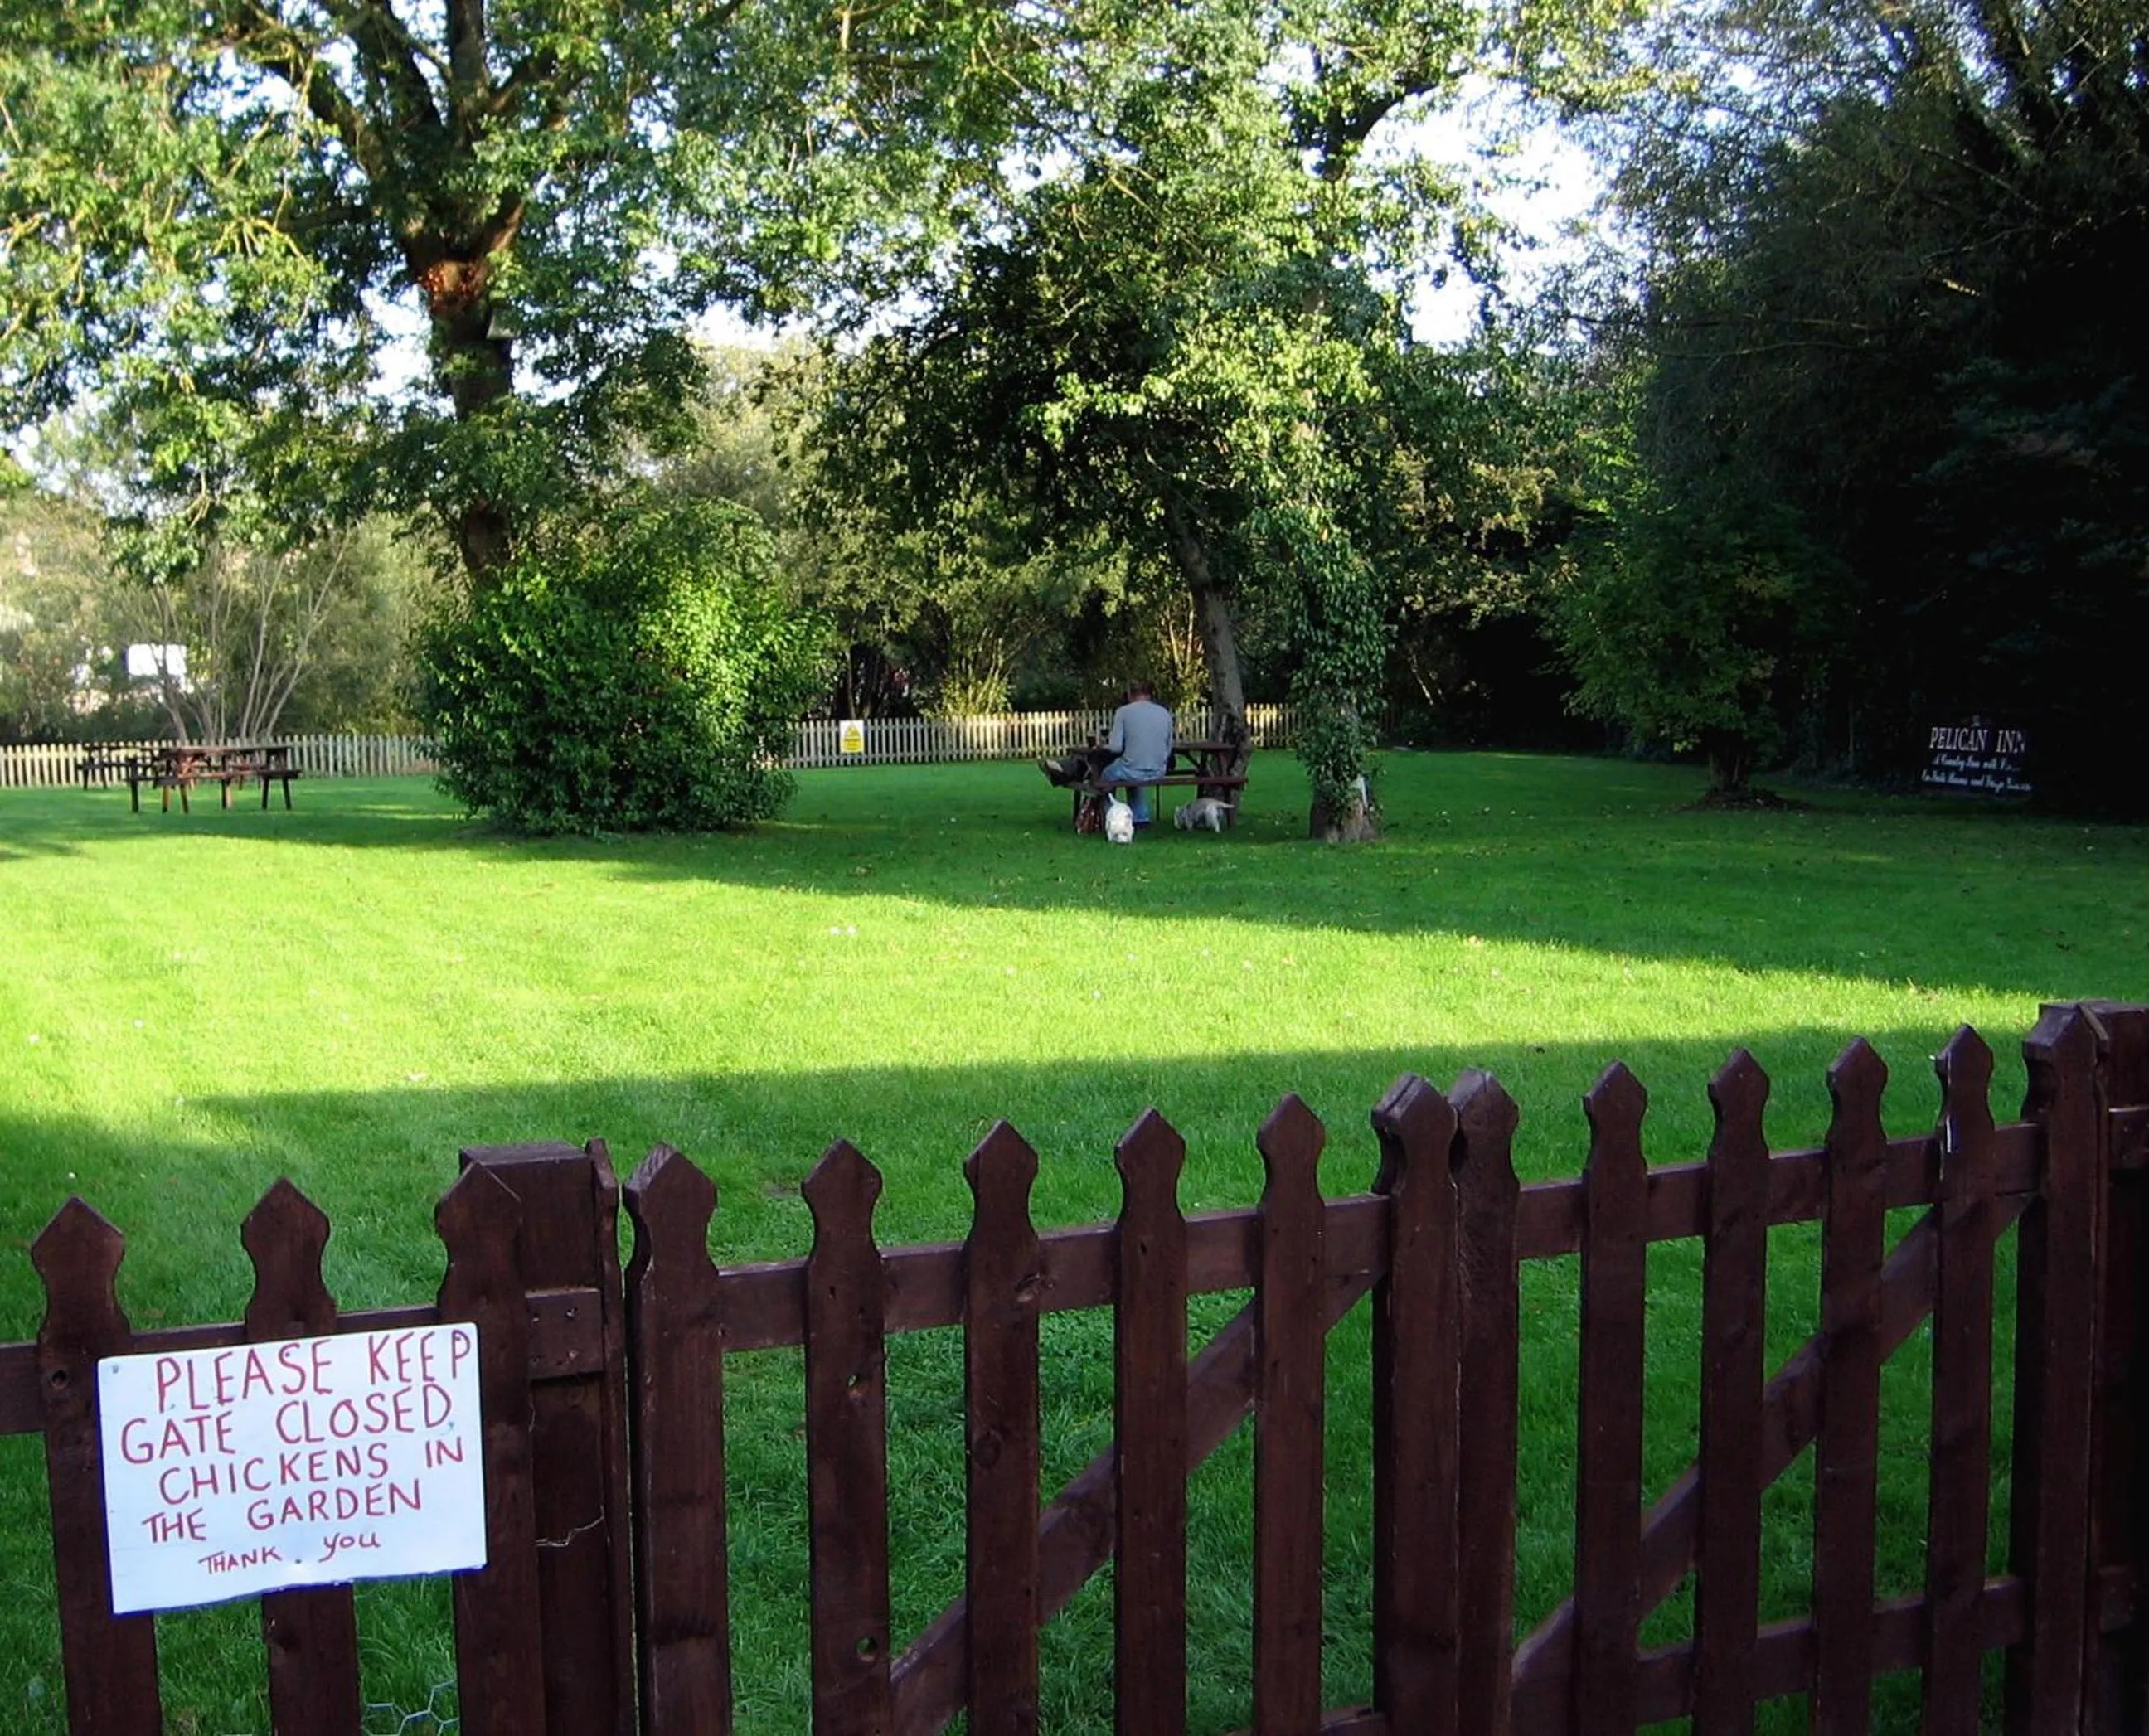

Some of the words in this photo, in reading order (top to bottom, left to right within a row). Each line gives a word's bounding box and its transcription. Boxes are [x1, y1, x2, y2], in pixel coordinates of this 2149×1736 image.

[1928, 726, 1988, 752] PELICAN
[156, 1339, 333, 1414] PLEASE
[368, 1329, 472, 1385] KEEP
[120, 1410, 236, 1464] GATE
[275, 1383, 453, 1444] CLOSED
[159, 1443, 390, 1506] CHICKENS
[424, 1435, 464, 1469] IN
[141, 1507, 207, 1544] THE
[246, 1478, 422, 1531] GARDEN
[198, 1545, 283, 1574] THANK
